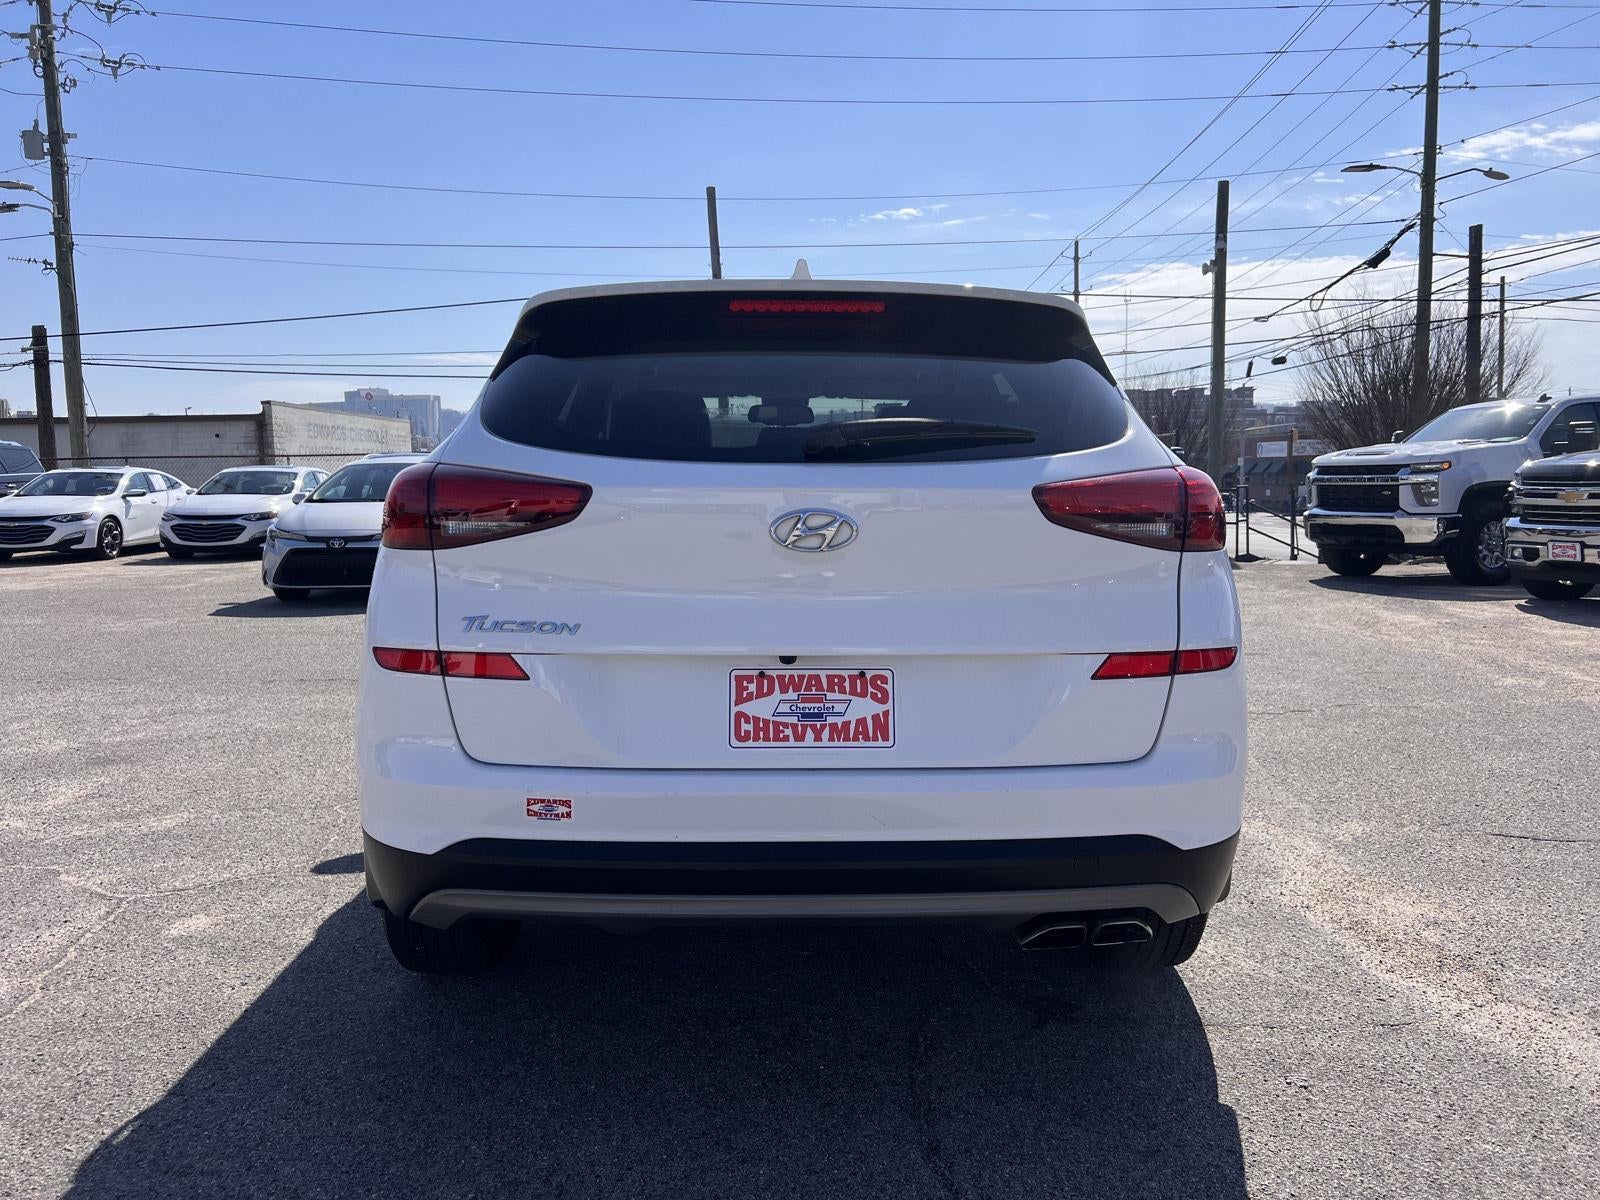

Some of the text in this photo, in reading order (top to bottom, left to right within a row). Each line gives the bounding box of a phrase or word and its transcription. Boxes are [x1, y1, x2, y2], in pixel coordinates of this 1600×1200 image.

[307, 422, 347, 441] EDWARDS
[462, 614, 581, 635] TUCSON
[734, 673, 890, 707] EDWARDS
[789, 703, 835, 713] Chevrolet
[734, 709, 890, 743] CHEVYMAN
[526, 797, 572, 809] EDWARDS
[526, 808, 572, 819] CHEVYMAN
